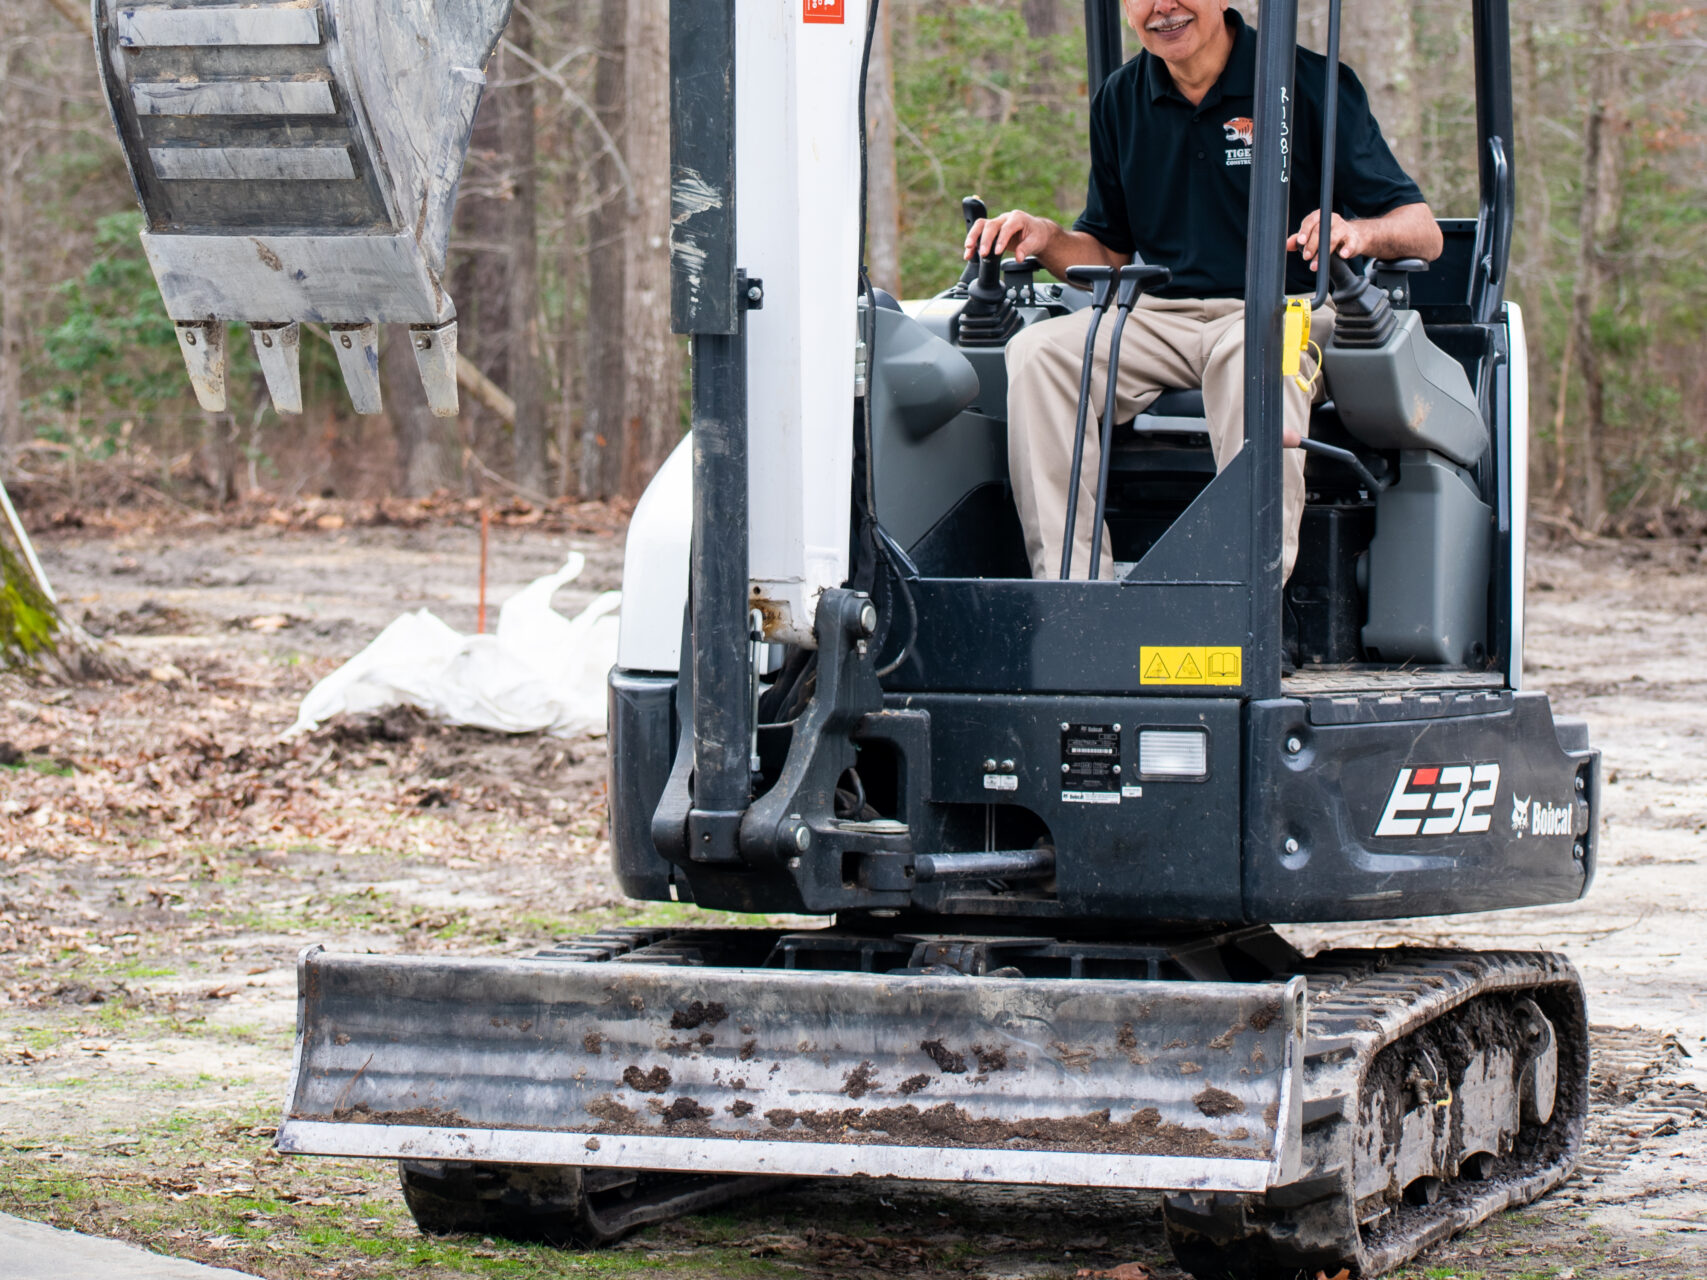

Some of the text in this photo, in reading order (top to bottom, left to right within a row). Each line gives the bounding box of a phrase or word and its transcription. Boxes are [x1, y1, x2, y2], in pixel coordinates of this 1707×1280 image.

[1225, 148, 1252, 158] TIGE
[1280, 86, 1289, 183] R13816
[1374, 763, 1501, 836] E32
[1531, 801, 1573, 836] Bobcat
